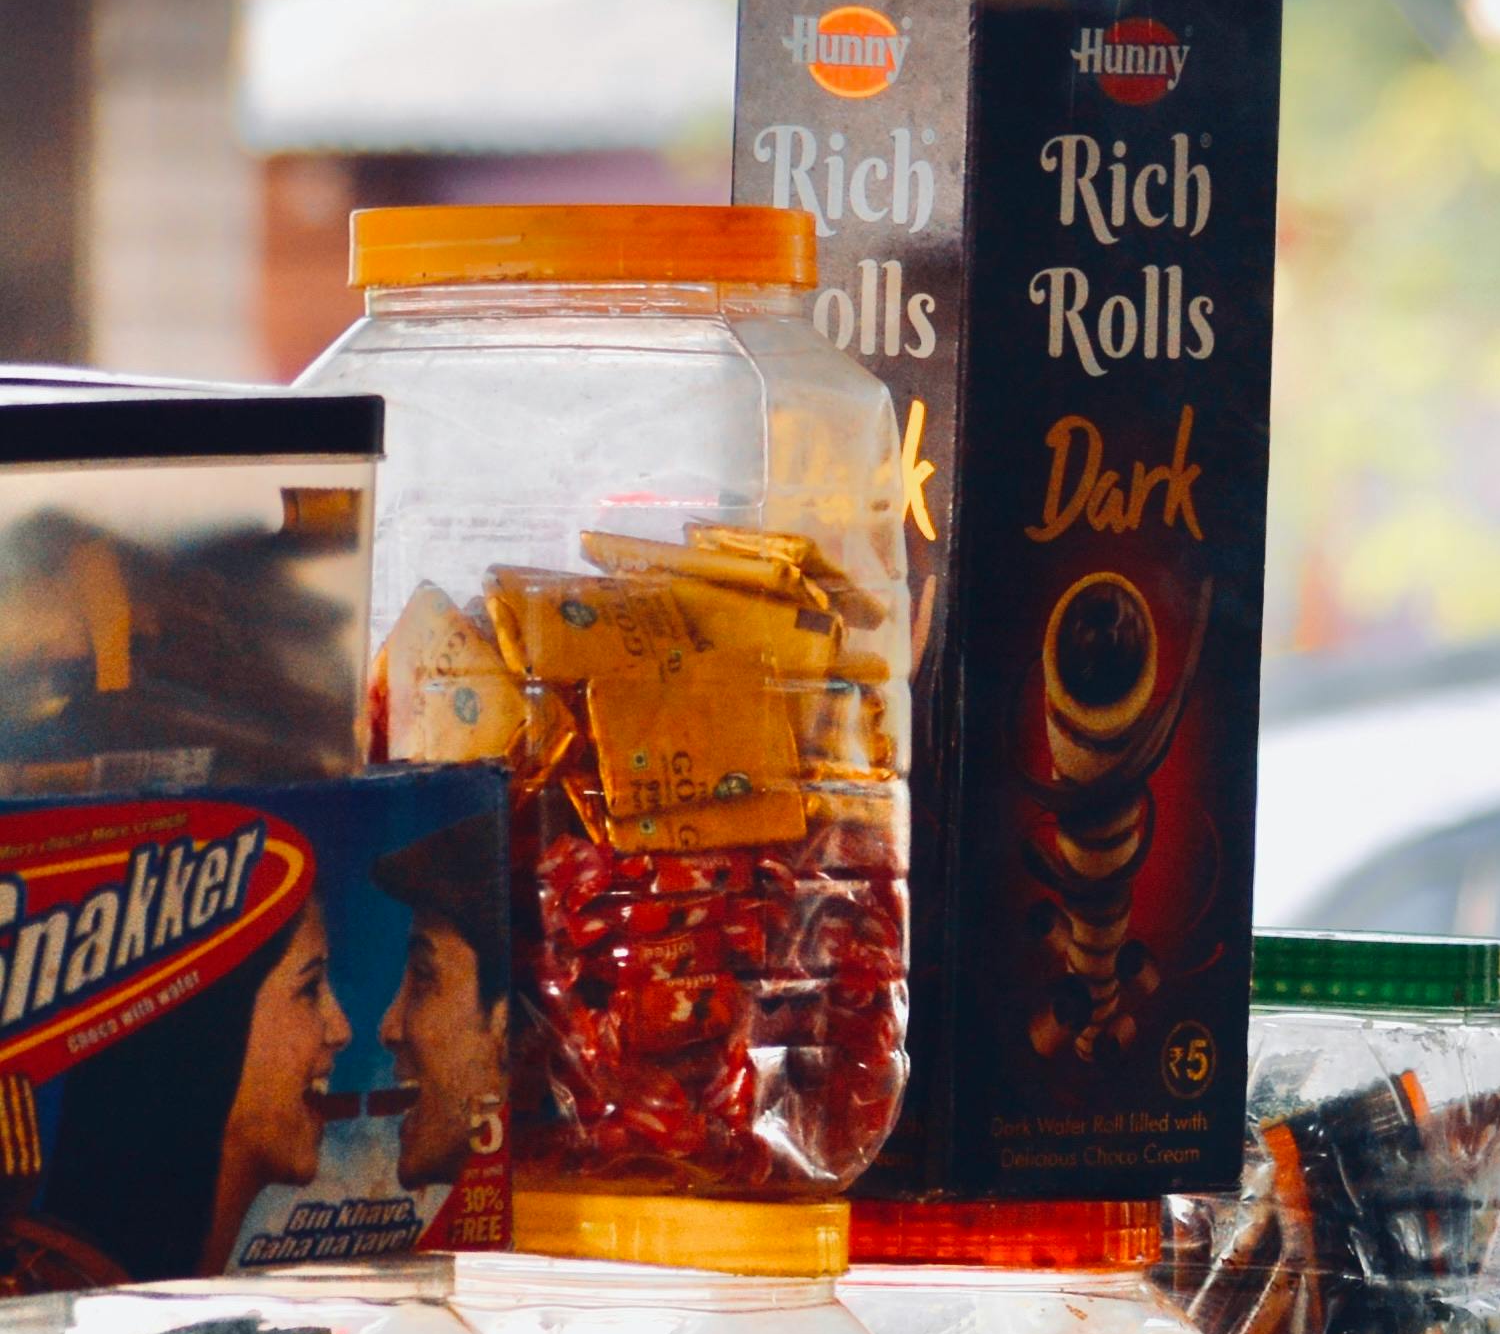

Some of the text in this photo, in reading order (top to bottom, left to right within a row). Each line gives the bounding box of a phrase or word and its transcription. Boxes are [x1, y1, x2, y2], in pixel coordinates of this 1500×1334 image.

[782, 15, 912, 85] Hunny
[1070, 27, 1191, 91] Hunny
[752, 124, 937, 239] Rich
[1040, 132, 1213, 245] Rich
[811, 258, 938, 359] olls
[1028, 264, 1216, 378] Rolls
[1023, 403, 1204, 543] Dark
[119, 999, 156, 1027] with
[991, 1110, 1209, 1139] Dark Wafer Roll filled with
[1001, 1142, 1201, 1169] Delicious Choco Cream
[290, 1206, 334, 1232] Bin
[462, 1185, 505, 1214] 30%
[245, 1238, 310, 1262] Raha
[314, 1238, 346, 1257] na
[452, 1217, 501, 1244] FREE
